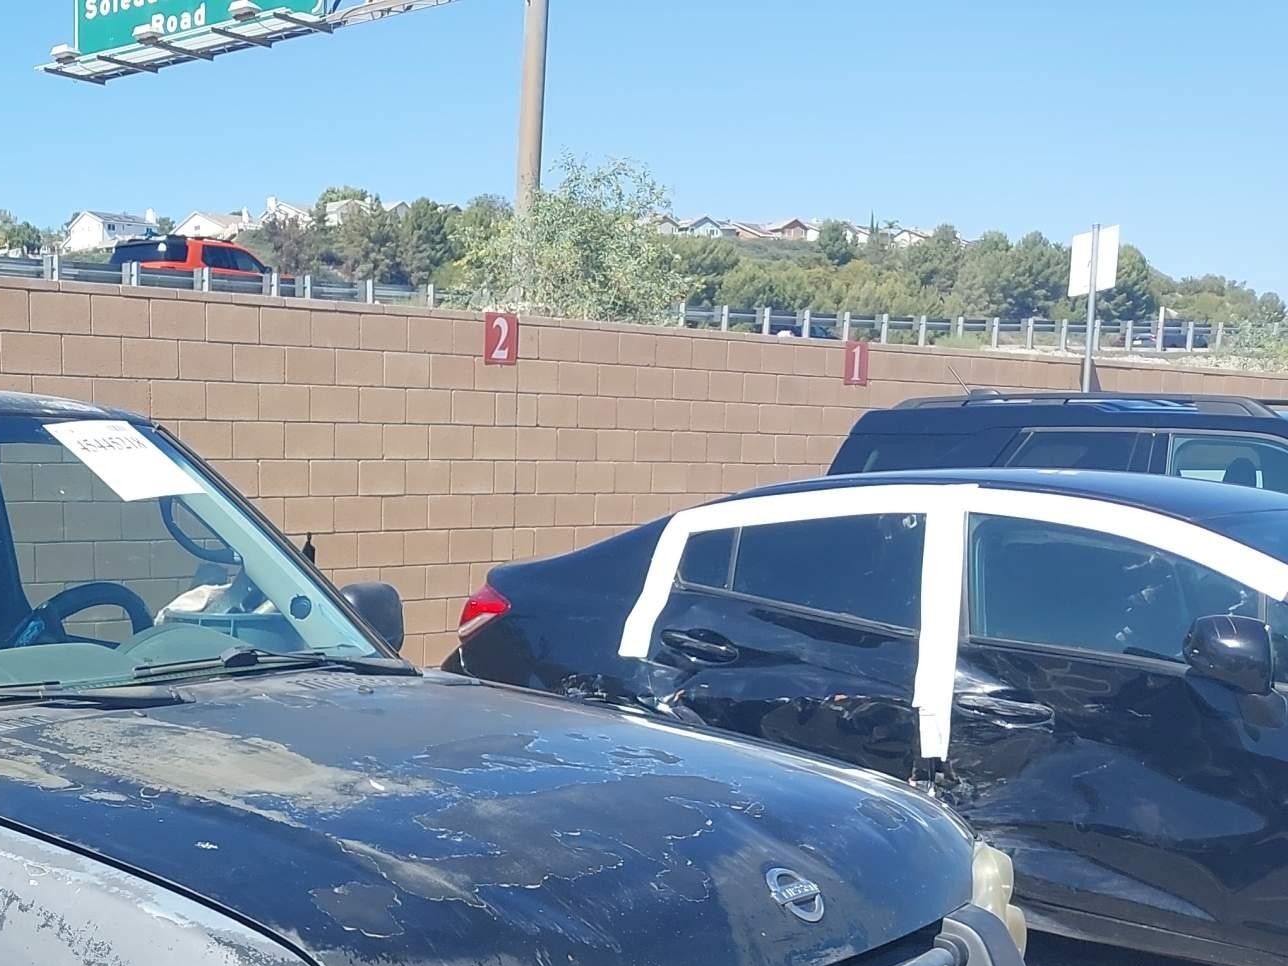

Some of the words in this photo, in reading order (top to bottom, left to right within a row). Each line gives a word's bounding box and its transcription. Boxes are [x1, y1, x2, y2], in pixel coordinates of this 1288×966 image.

[152, 3, 206, 33] Road
[491, 317, 509, 359] 2
[851, 344, 861, 381] 1
